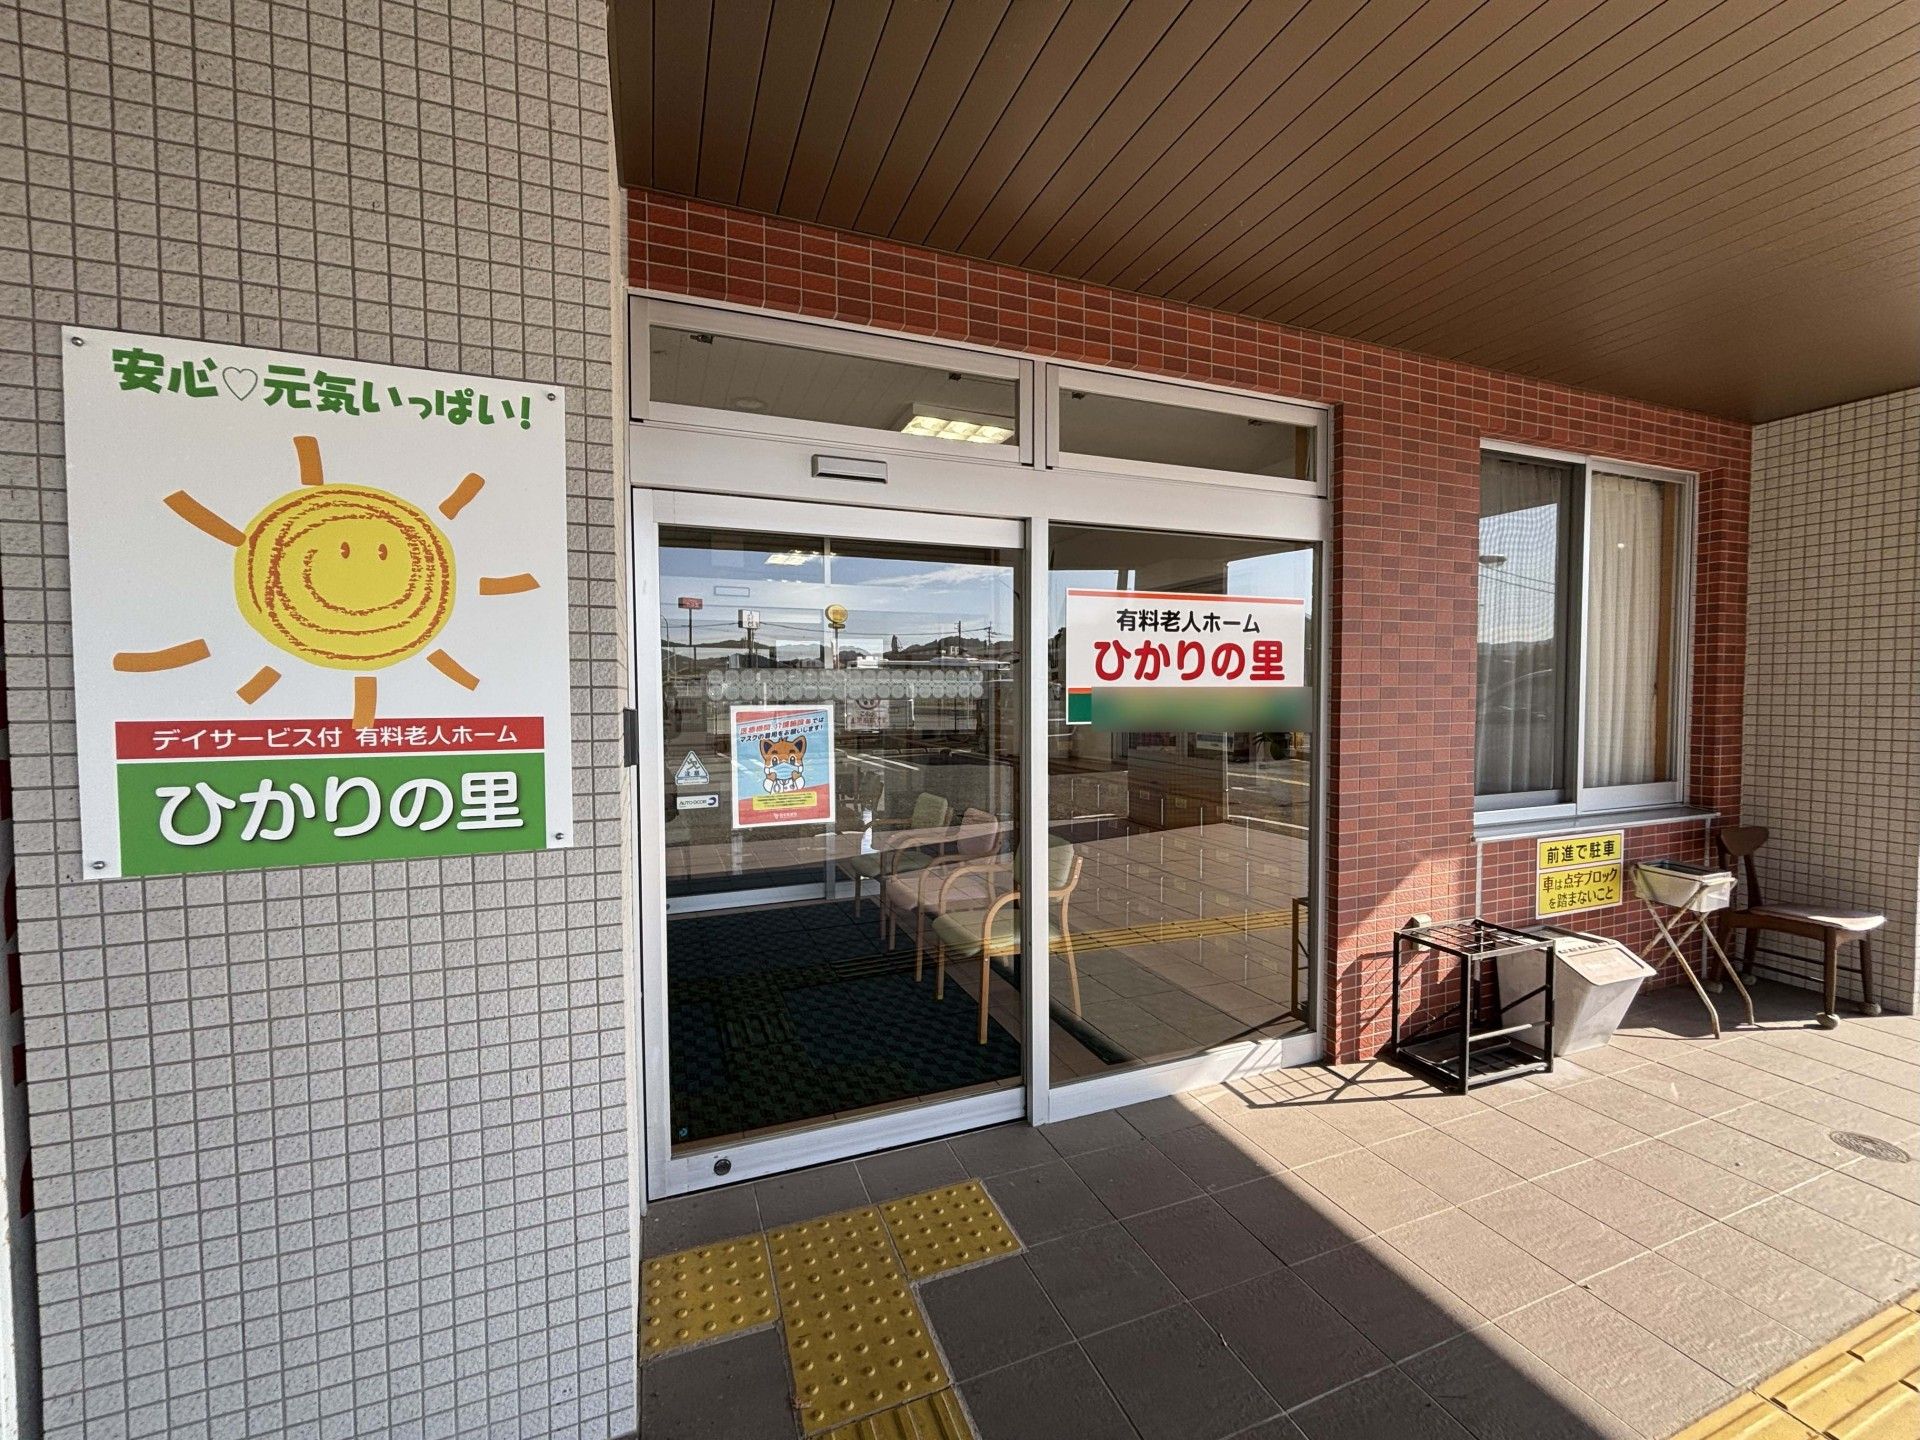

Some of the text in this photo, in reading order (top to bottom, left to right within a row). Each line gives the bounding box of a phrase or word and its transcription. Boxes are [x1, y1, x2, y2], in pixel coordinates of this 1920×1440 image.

[1116, 608, 1260, 633] 有料老人ホーム
[1093, 639, 1285, 682] ひかりの里
[152, 725, 518, 751] デイサービス付 有料老人ホーム
[154, 770, 525, 846] ひかりの里
[1546, 839, 1616, 865] 前進で駐車
[1542, 867, 1618, 893] 車は点字ブロック
[1548, 885, 1614, 910] を踏まないこと
